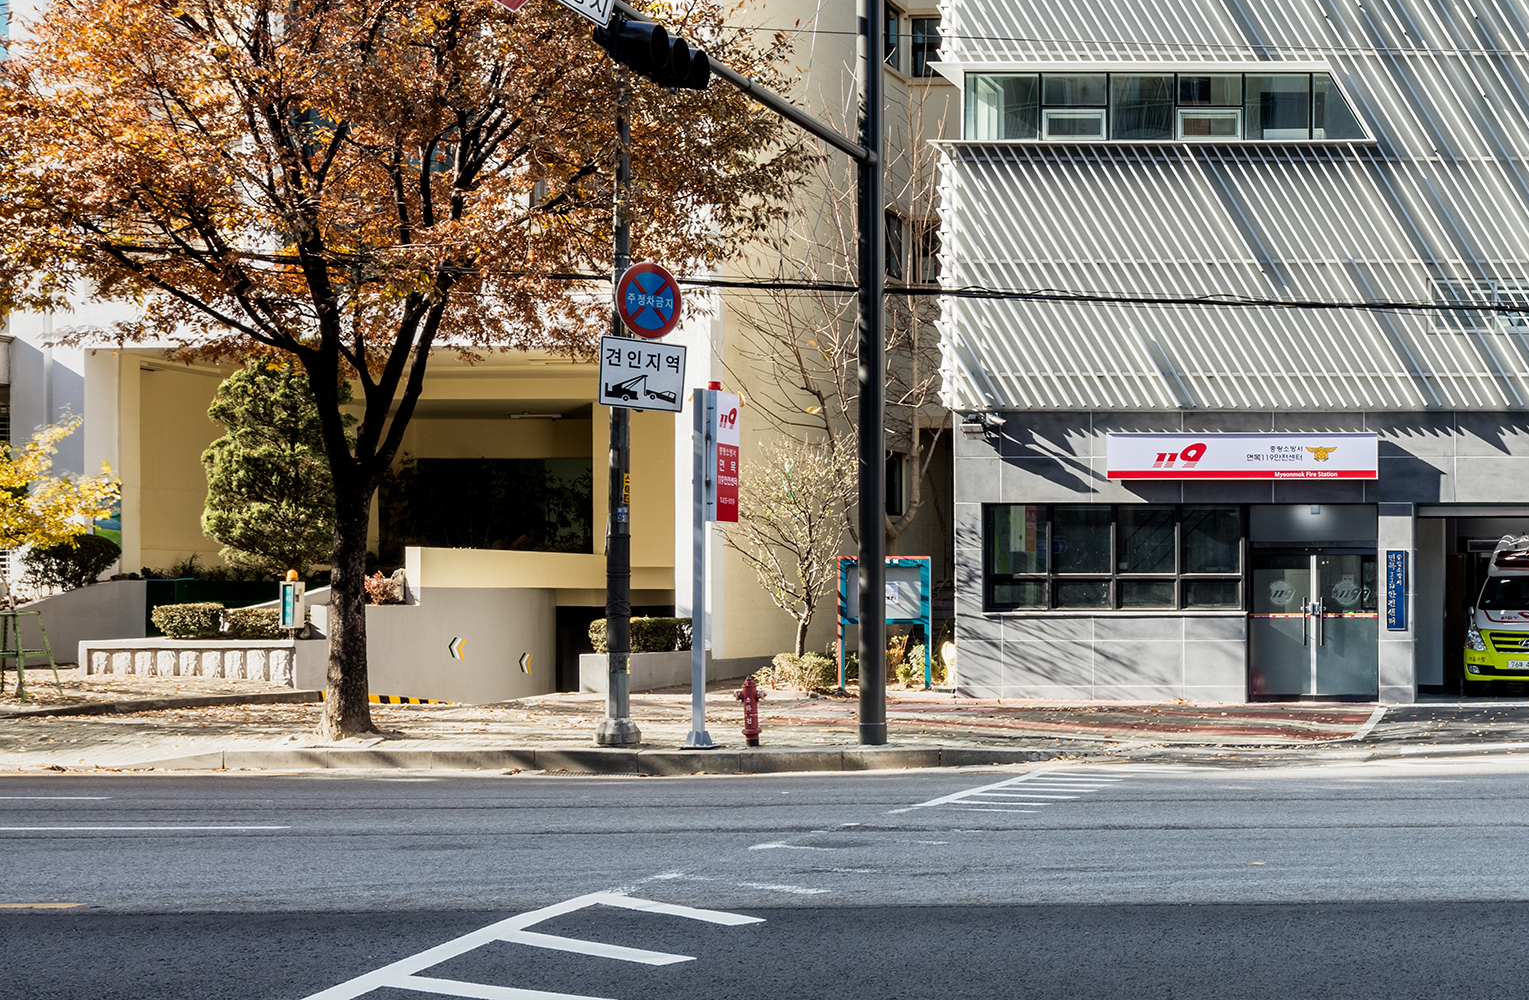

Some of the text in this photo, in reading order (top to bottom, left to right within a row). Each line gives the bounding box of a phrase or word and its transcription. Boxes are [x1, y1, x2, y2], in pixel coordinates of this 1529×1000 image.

[627, 293, 673, 309] 주정차금지
[606, 348, 680, 373] 견인지역
[1152, 442, 1207, 468] 119
